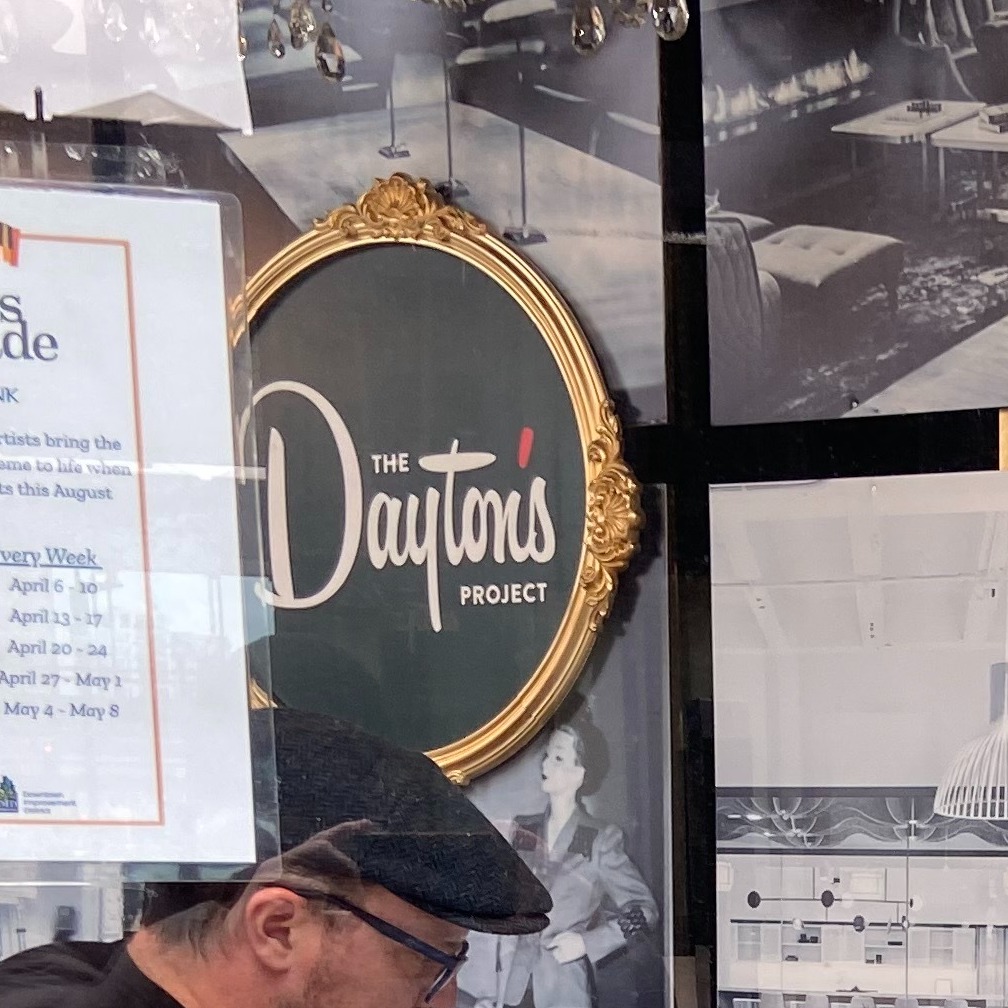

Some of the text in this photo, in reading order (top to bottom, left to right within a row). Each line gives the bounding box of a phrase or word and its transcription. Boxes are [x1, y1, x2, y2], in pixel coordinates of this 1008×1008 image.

[43, 432, 90, 453] bring
[95, 435, 121, 450] the
[36, 460, 53, 472] to
[86, 460, 132, 476] when
[371, 453, 410, 473] THE
[18, 481, 50, 497] this
[53, 484, 113, 502] August
[45, 548, 97, 566] Week
[9, 578, 49, 596] April
[54, 580, 64, 593] 6
[459, 582, 548, 606] PROJECT
[9, 608, 49, 626] April
[53, 611, 70, 626] 13
[85, 612, 102, 628] 17
[8, 639, 47, 657] April
[51, 643, 72, 655] 20
[88, 644, 107, 658] 24
[0, 671, 36, 688] April
[41, 674, 60, 688] 27
[76, 672, 111, 691] May
[115, 675, 122, 687] 1
[4, 701, 39, 720] May
[44, 705, 54, 718] 4
[70, 703, 106, 721] May
[109, 704, 120, 718] 8
